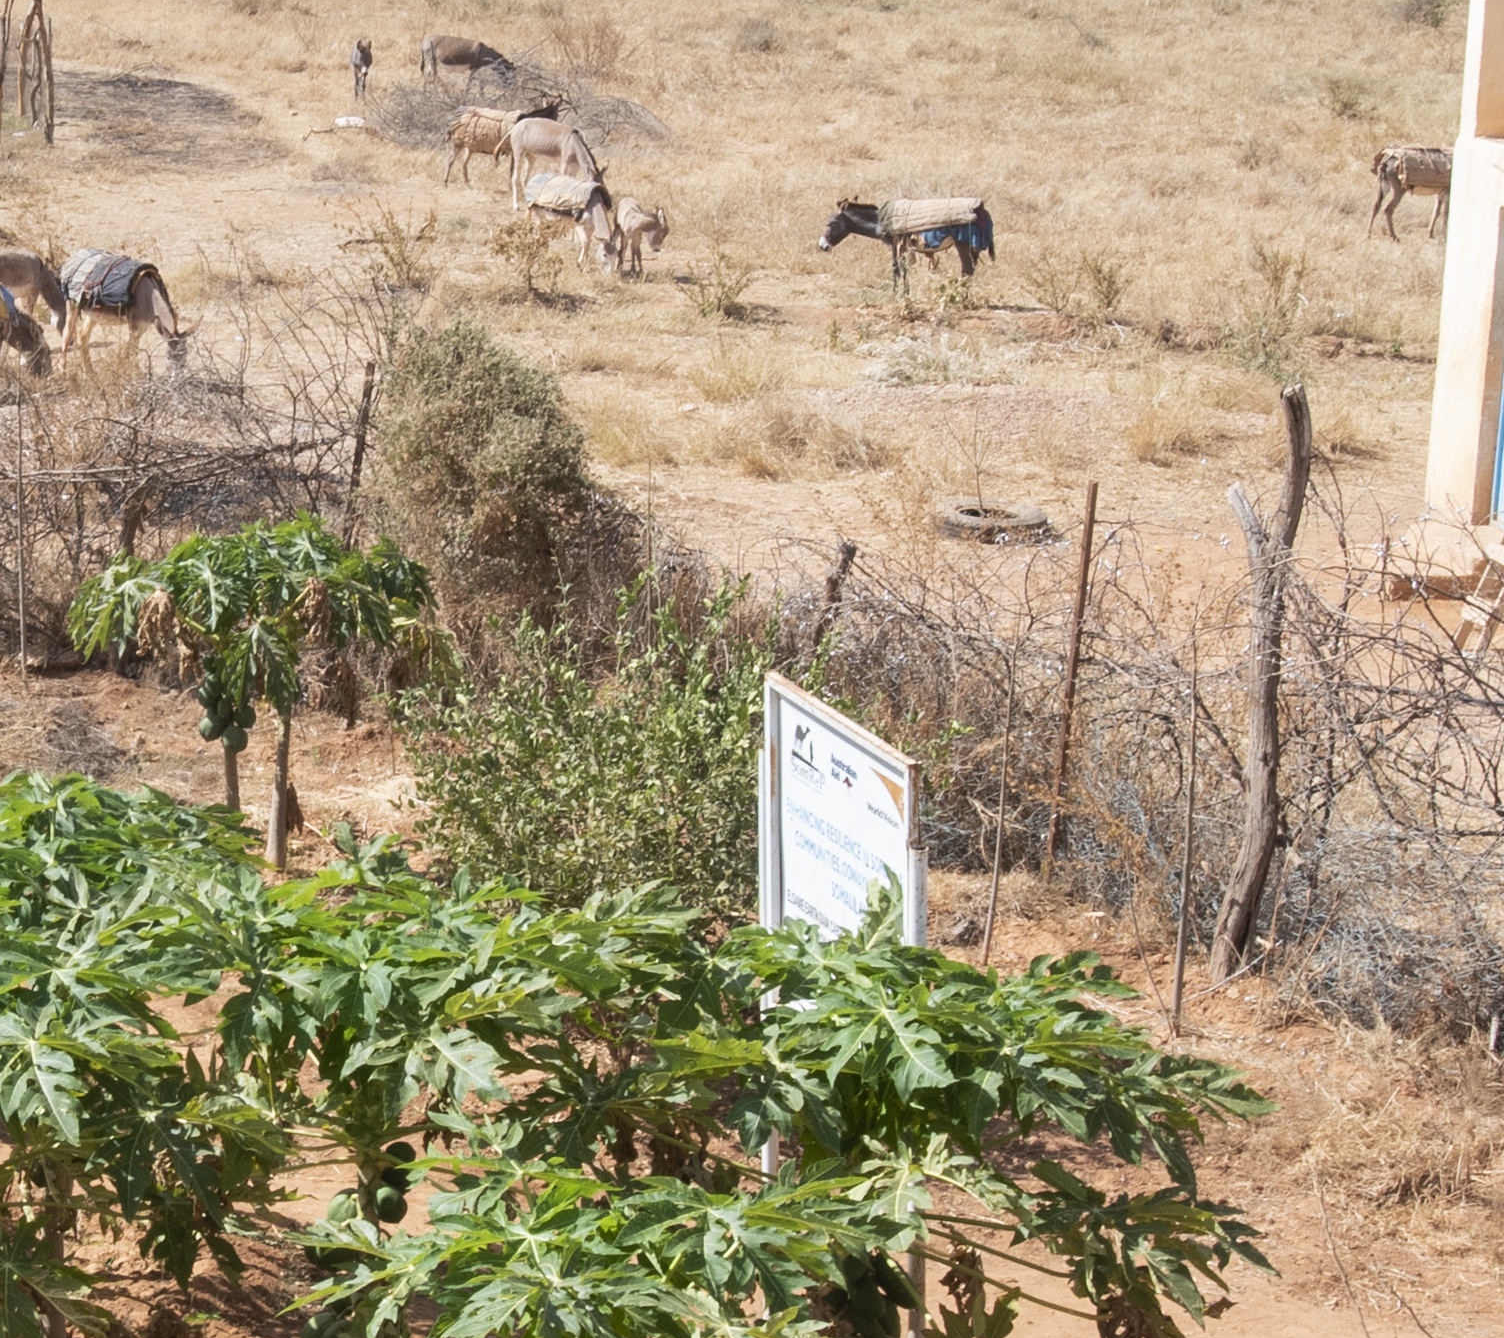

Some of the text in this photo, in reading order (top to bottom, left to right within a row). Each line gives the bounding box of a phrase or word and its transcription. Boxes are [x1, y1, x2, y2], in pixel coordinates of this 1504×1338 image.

[790, 756, 825, 790] SomReP
[830, 766, 840, 781] Aid
[786, 796, 825, 836] ENHANCING
[826, 822, 861, 861] RESILIENCE
